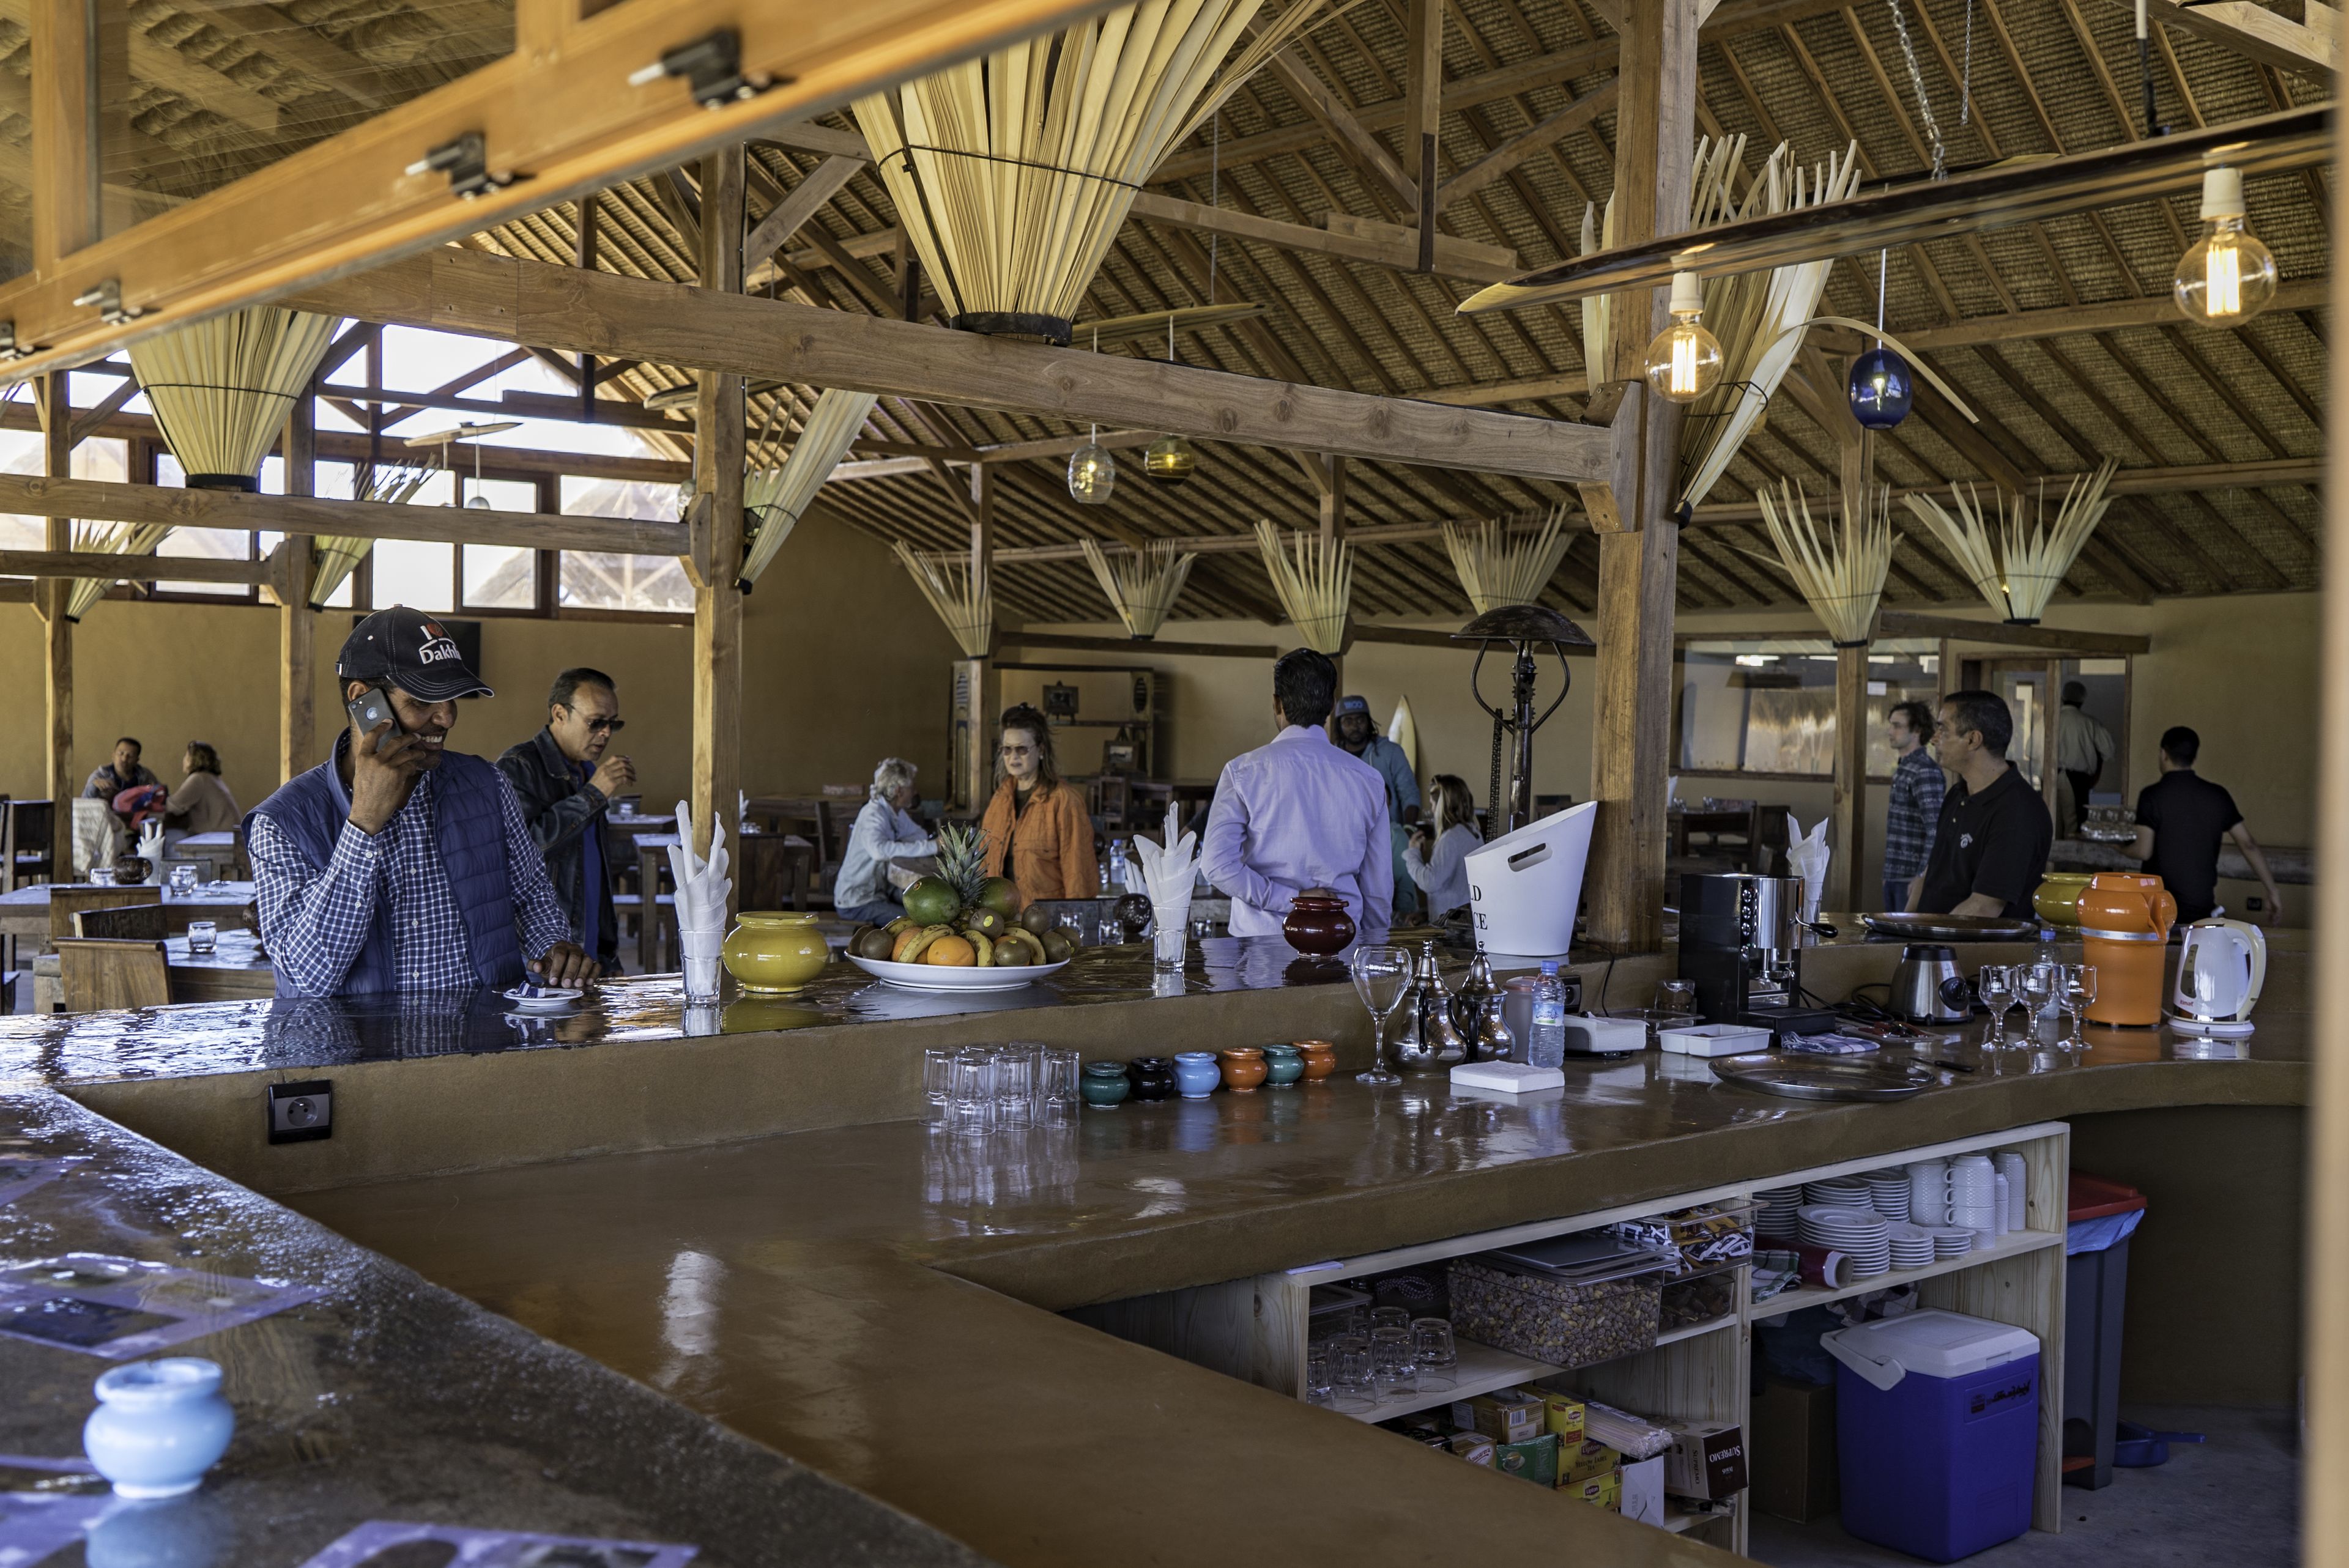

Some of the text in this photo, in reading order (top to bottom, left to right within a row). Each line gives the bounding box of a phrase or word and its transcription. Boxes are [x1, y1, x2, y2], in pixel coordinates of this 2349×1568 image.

[420, 625, 432, 640] I
[1582, 1444, 1600, 1454] Lipton
[1709, 1445, 1741, 1462] SUPREMO
